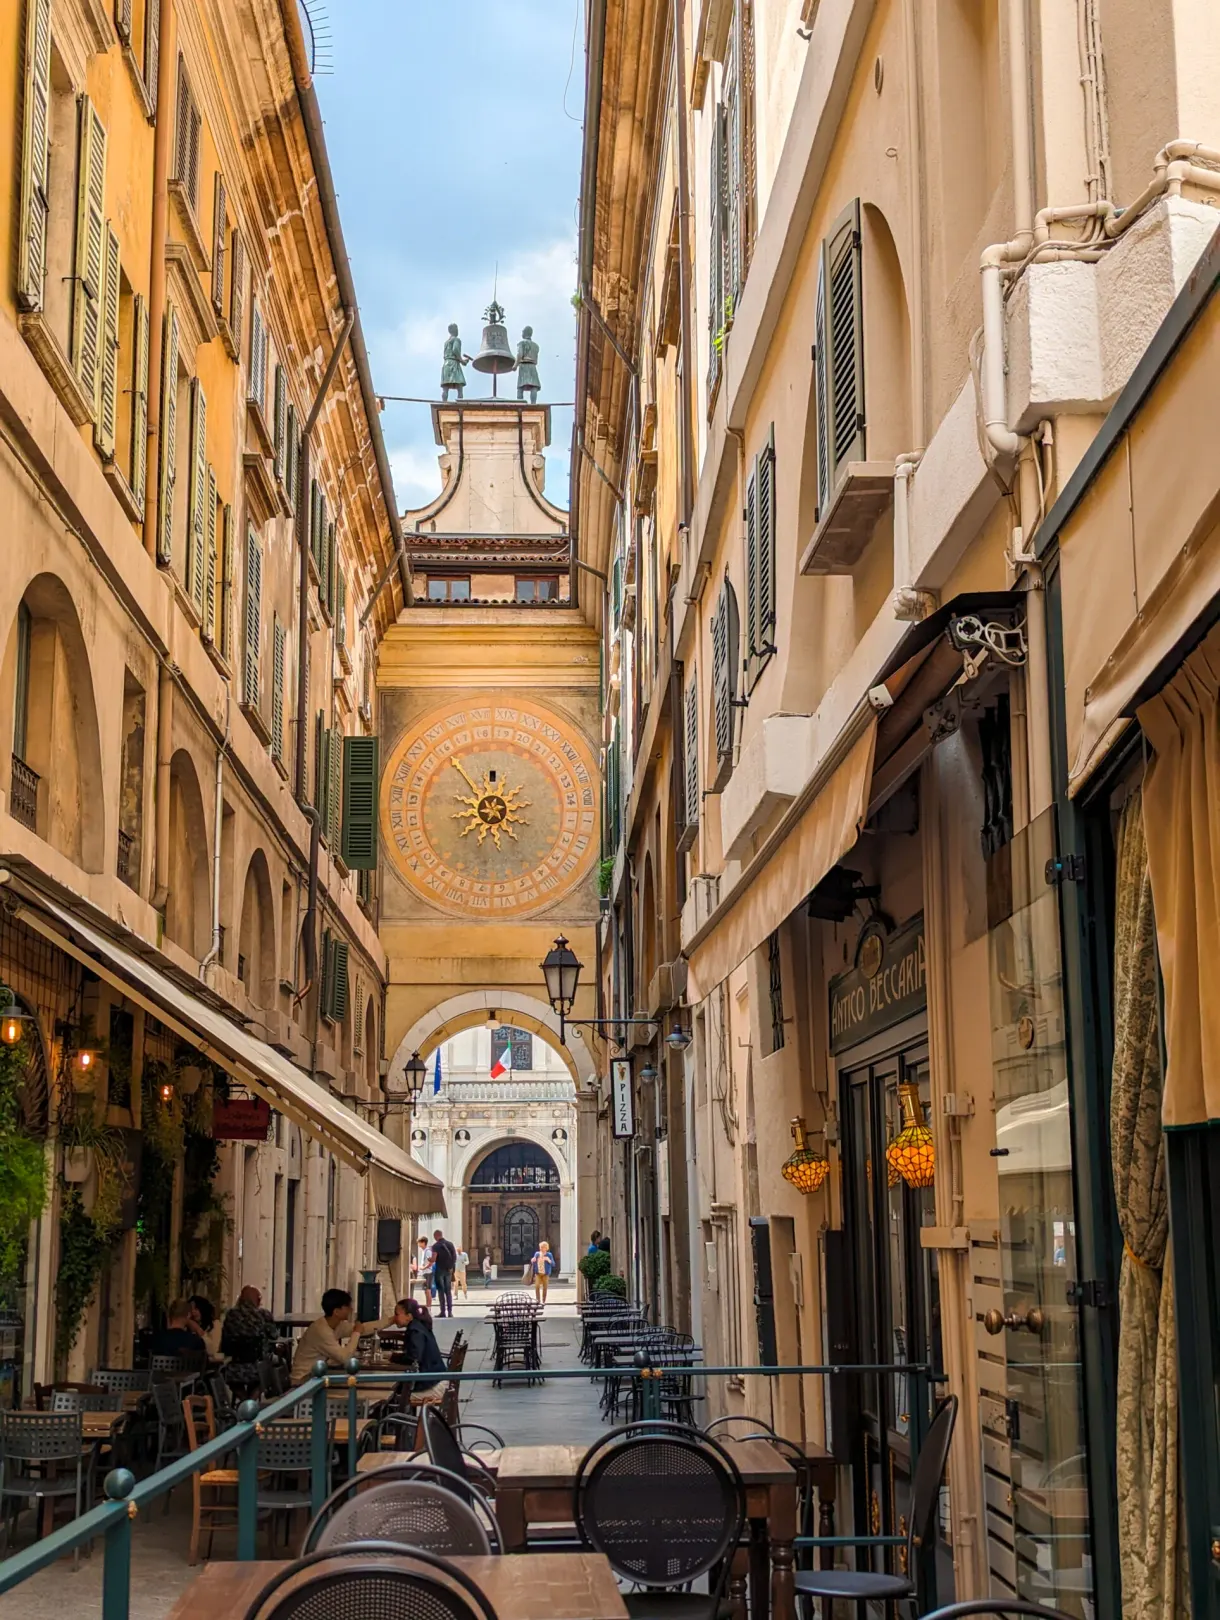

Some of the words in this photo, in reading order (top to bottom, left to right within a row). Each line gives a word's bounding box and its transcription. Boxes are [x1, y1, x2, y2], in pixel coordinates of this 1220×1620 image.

[446, 713, 466, 727] XVII
[495, 709, 516, 720] XIX
[520, 714, 540, 729] XX
[425, 724, 445, 742] XVI
[455, 733, 468, 744] 17
[476, 729, 489, 738] 18
[496, 729, 510, 738] 19
[516, 733, 530, 744] 20
[542, 725, 560, 743] XXI
[408, 742, 424, 760] XV
[439, 744, 450, 755] 16
[534, 743, 547, 755] 21
[560, 741, 578, 762] XXII
[424, 757, 435, 770] 15
[549, 757, 561, 771] 22
[572, 762, 589, 784] XXIII
[414, 776, 424, 787] 14
[560, 774, 571, 789] 23
[408, 794, 418, 805] 13
[566, 793, 576, 806] 24
[391, 812, 404, 829] XII
[409, 813, 418, 826] 12
[397, 837, 410, 851] XI
[413, 835, 423, 845] 11
[575, 839, 587, 851] II
[423, 852, 435, 866] 10
[551, 854, 560, 862] 3
[410, 859, 422, 871] X
[562, 859, 575, 873] III
[427, 877, 441, 890] IX
[459, 879, 466, 888] 8
[499, 884, 506, 893] 6
[519, 879, 525, 888] 5
[543, 875, 559, 890] IIII
[445, 888, 464, 903] VIII
[471, 896, 487, 906] VII
[500, 897, 512, 907] VI
[527, 891, 535, 901] V
[832, 986, 865, 1039] ANTICO
